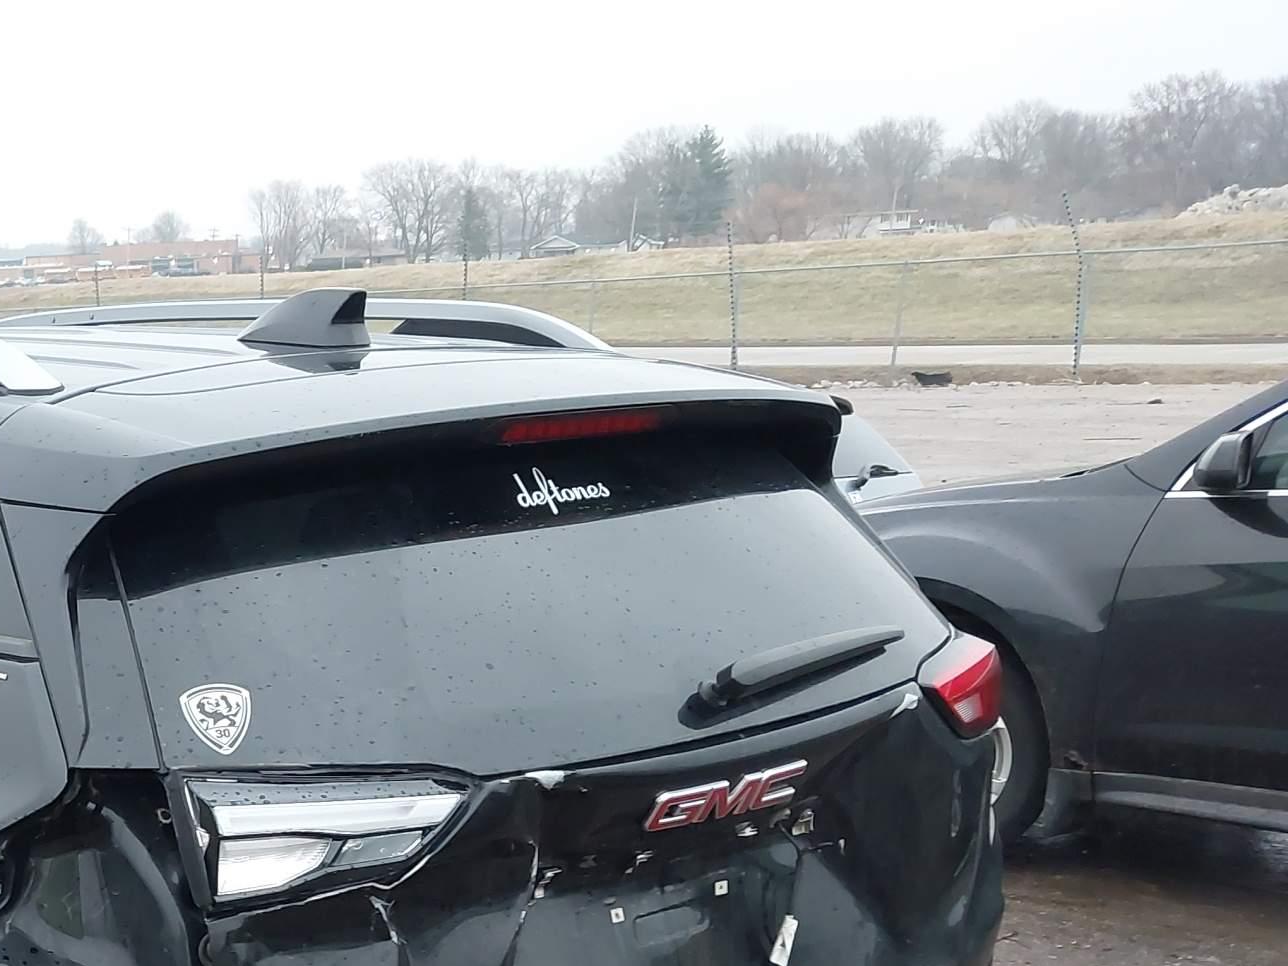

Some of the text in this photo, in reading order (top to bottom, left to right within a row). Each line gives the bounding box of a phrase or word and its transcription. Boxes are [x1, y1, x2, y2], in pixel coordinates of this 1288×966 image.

[513, 467, 610, 515] deftones
[215, 728, 231, 738] 30
[645, 759, 808, 831] GMC
